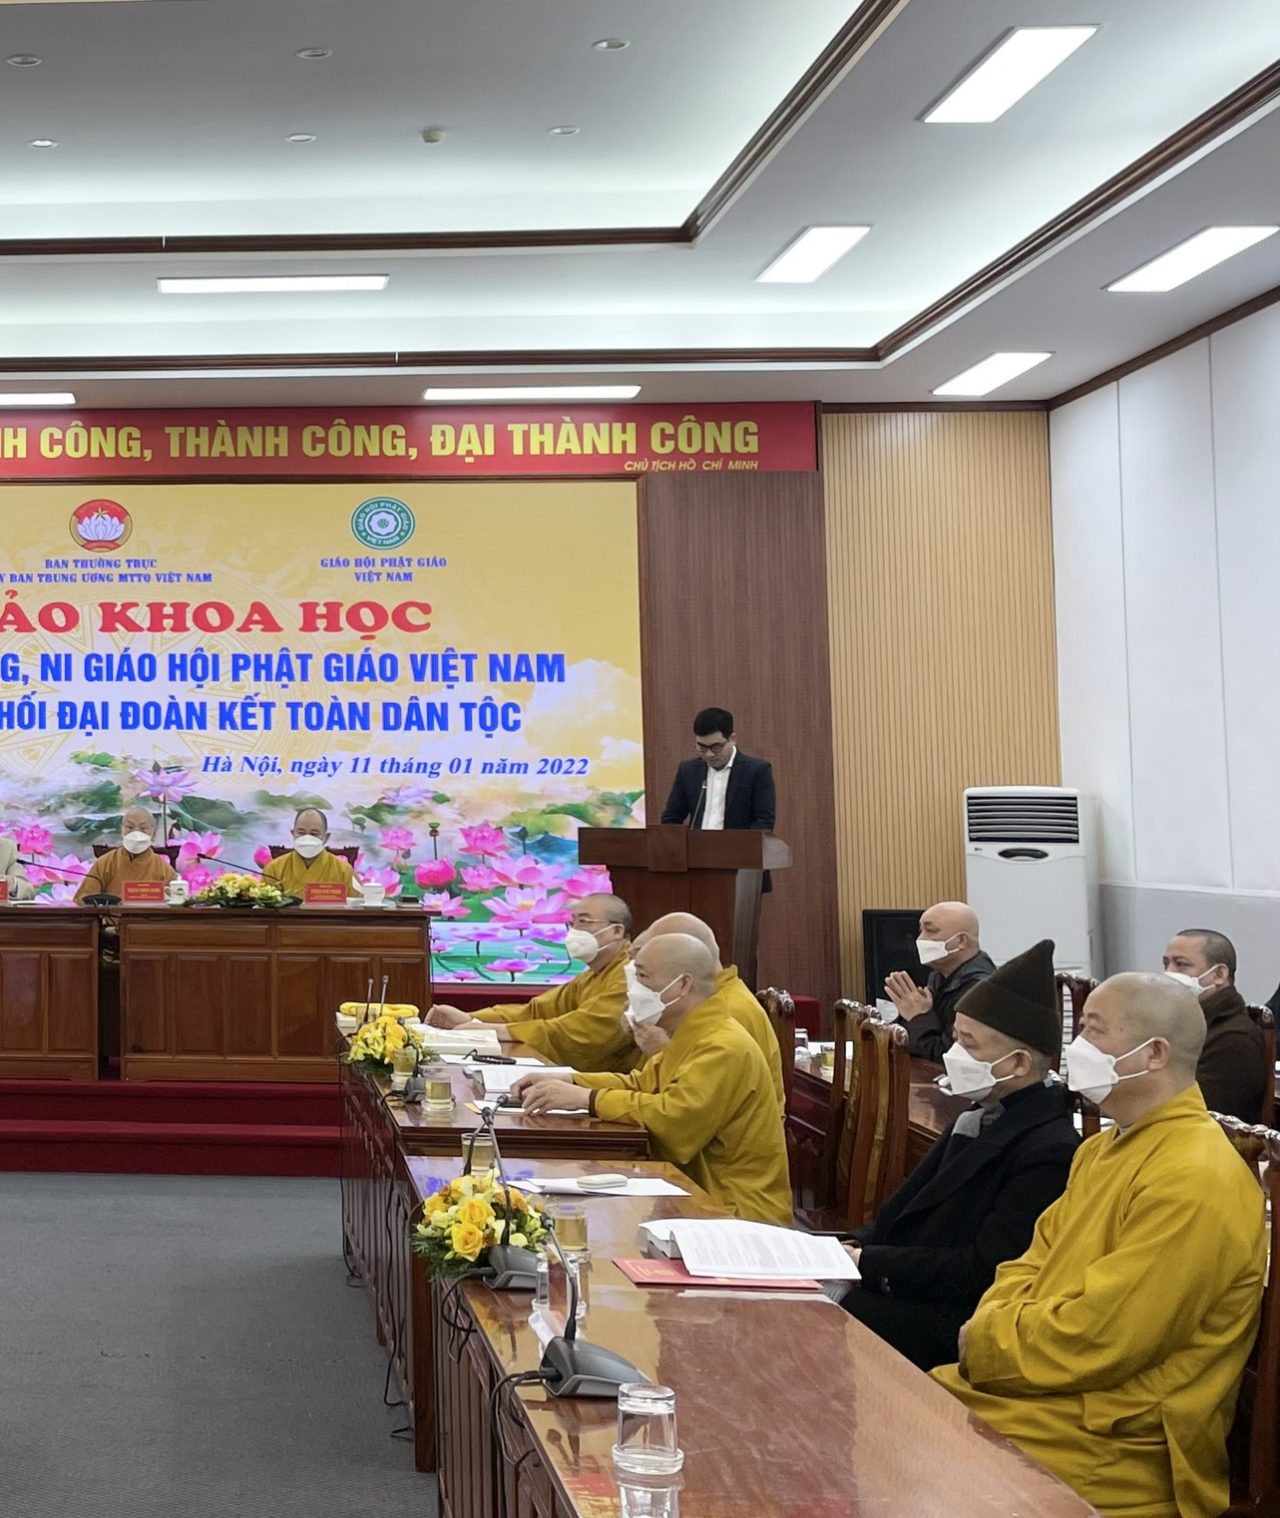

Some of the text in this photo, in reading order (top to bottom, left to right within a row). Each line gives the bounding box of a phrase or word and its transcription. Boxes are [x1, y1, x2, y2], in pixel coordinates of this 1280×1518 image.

[39, 418, 153, 462] CÔNG,
[166, 418, 288, 458] THÀNH
[302, 417, 418, 460] CÔNG,
[430, 423, 496, 464] ĐẠI
[507, 416, 637, 455] THÀNH
[650, 415, 759, 455] CÔNG
[624, 457, 759, 473] CHỦ TỊCH HỒ CHÍ MINH
[44, 557, 158, 571] BAN THƯỜNG TRỰC
[320, 556, 447, 569] GIÁO HỘI PHẬT GIÁO
[9, 573, 34, 583] BAN
[37, 573, 78, 583] TRUNG
[81, 572, 114, 583] ƯƠNG
[155, 571, 182, 584] VIỆT
[186, 573, 213, 583] NAM
[354, 570, 413, 583] VIỆT NAM
[99, 600, 283, 634] KHOA
[299, 600, 433, 641] HỌC
[40, 652, 74, 683] NI
[83, 647, 158, 684] GIÁO
[167, 647, 221, 690] HỘI
[230, 647, 313, 690] PHẬT
[323, 648, 400, 684] GIÁO
[409, 647, 478, 690] VIỆT
[488, 653, 567, 684] NAM
[56, 699, 110, 737] ĐẠI
[118, 694, 208, 731] ĐOÀN
[217, 692, 277, 731] KẾT
[286, 696, 371, 732] TOÀN
[381, 695, 450, 732] DÂN
[458, 695, 523, 739] TỘC
[201, 755, 589, 779] Hà Nội, ngày 11 tháng 01 năm 2022
